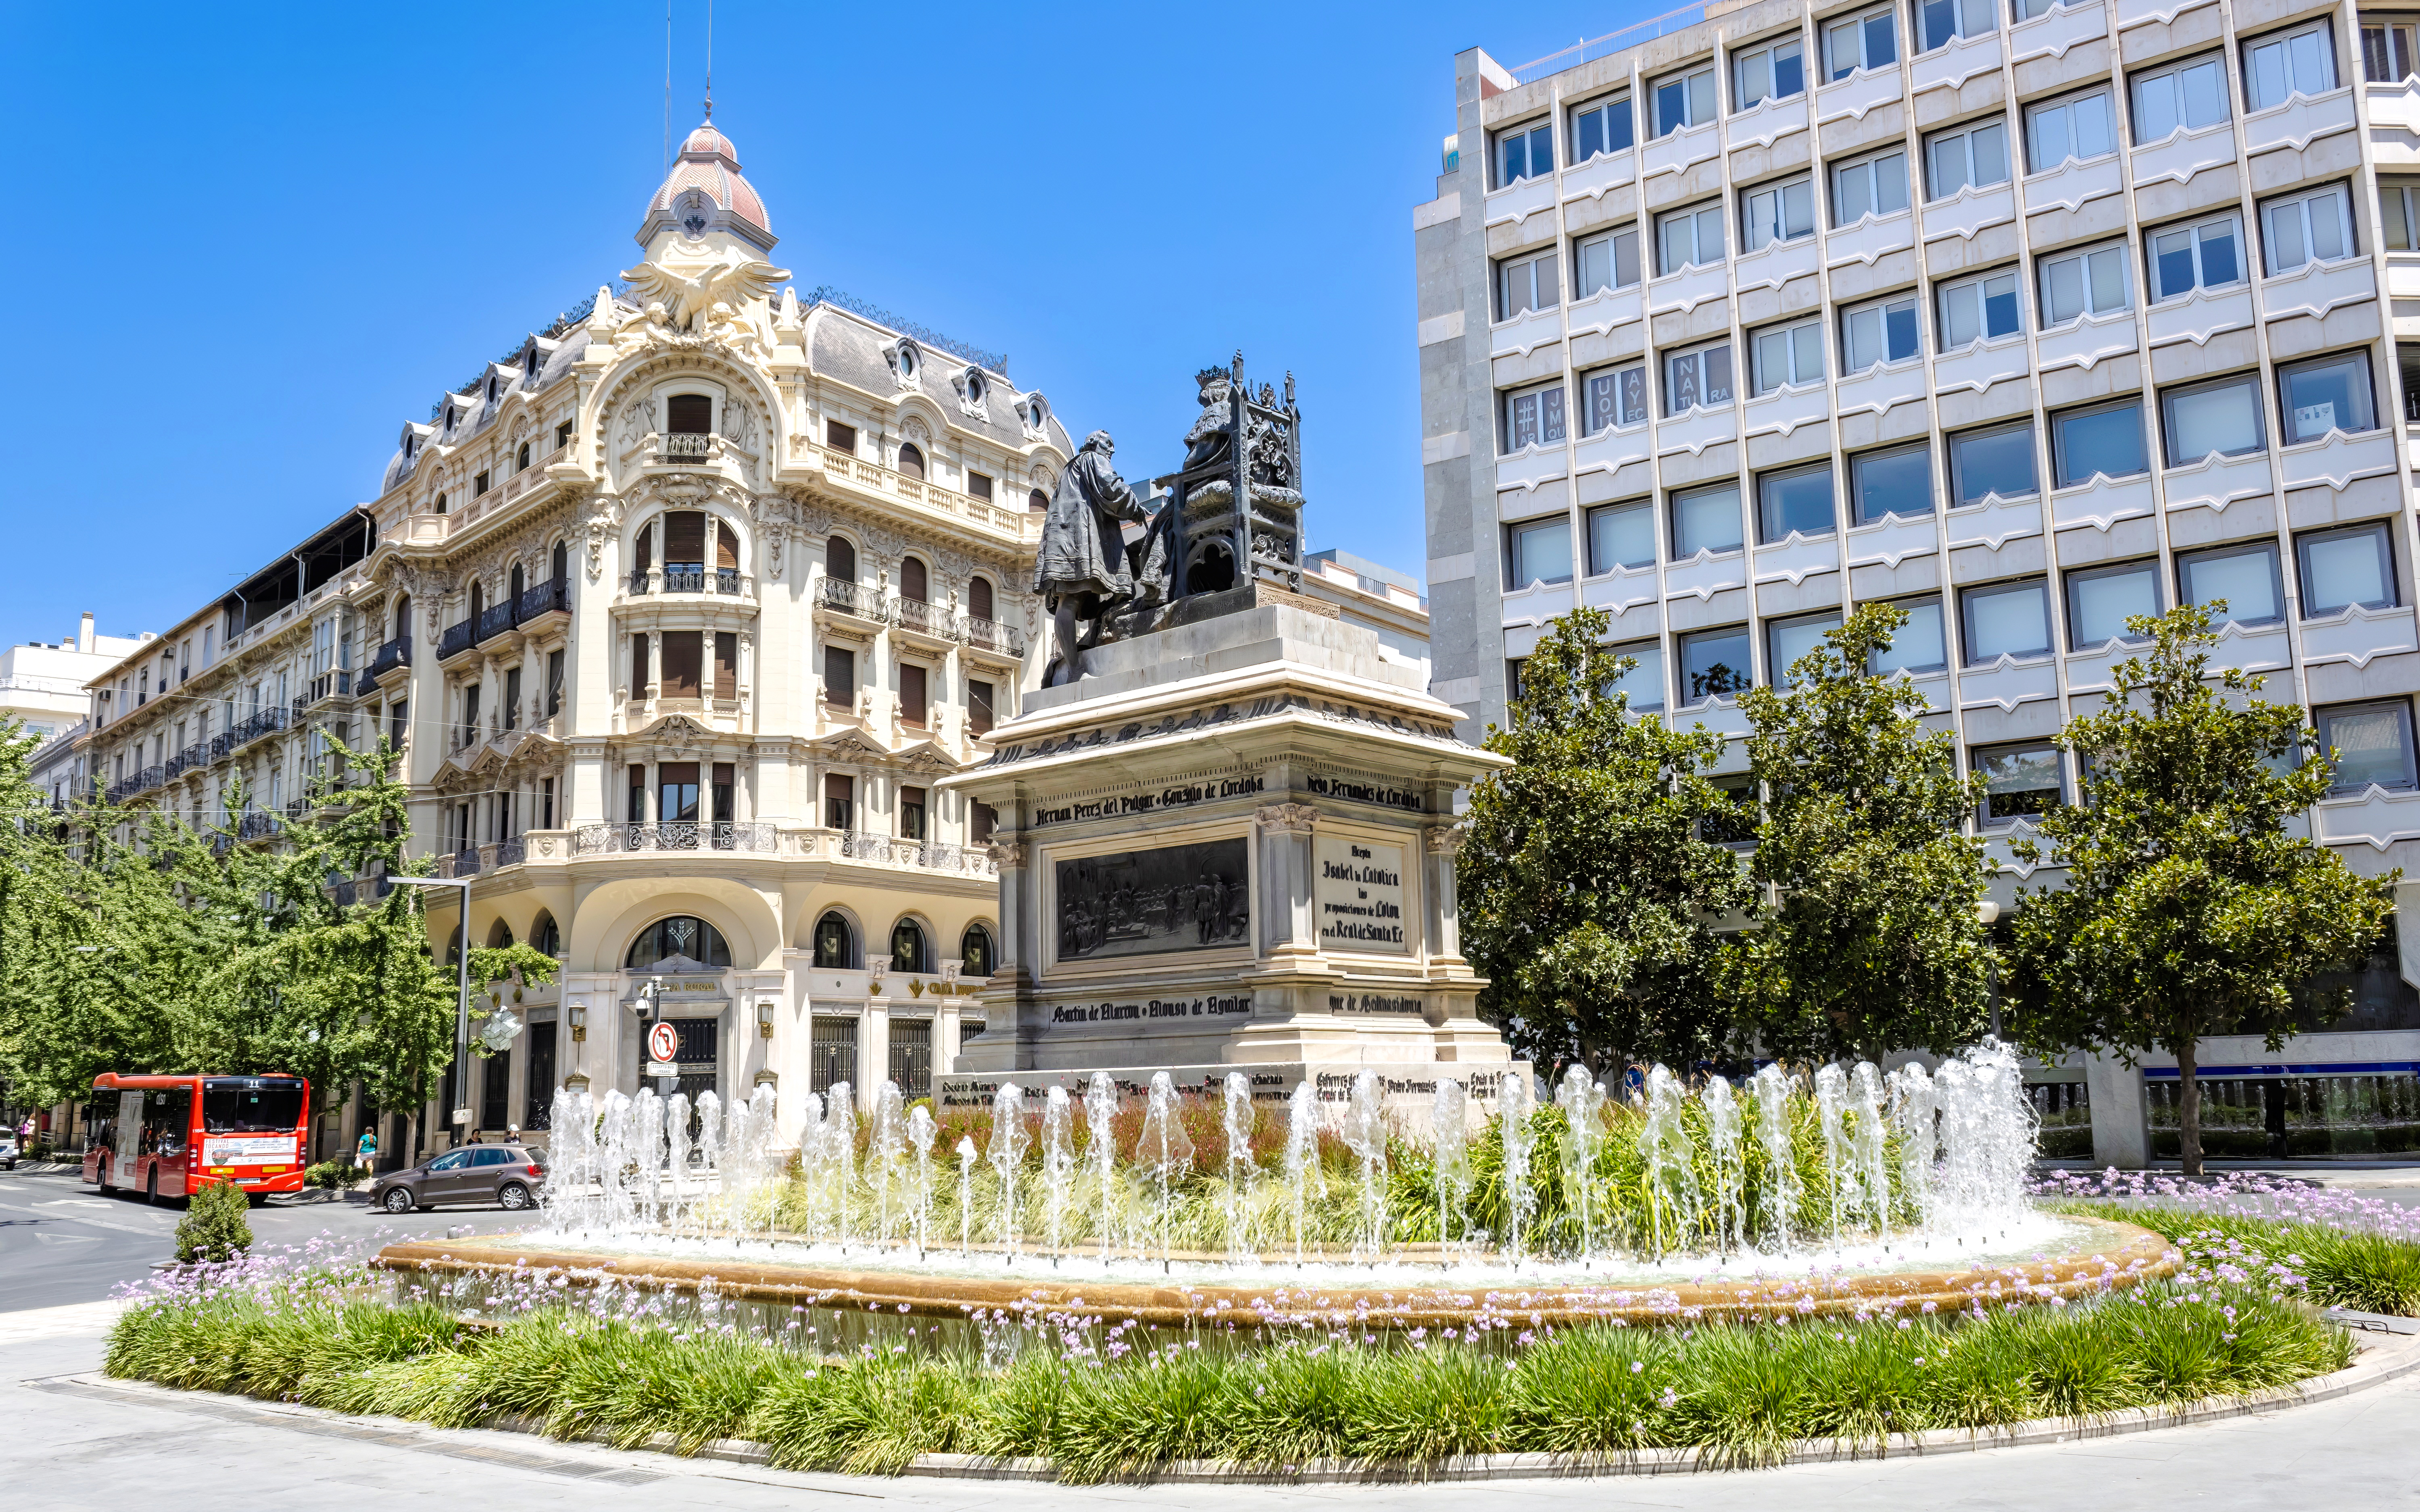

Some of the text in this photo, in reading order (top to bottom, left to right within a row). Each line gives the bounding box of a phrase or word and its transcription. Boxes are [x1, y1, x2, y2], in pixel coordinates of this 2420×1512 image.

[1035, 808, 1072, 826] Hernan
[1104, 798, 1118, 814] del
[1120, 794, 1155, 814] Pulgar
[1205, 782, 1216, 799] de
[1220, 775, 1264, 798] Cordoba
[1329, 779, 1374, 802] Fernandez
[1376, 786, 1385, 803] de
[1386, 788, 1421, 809] Cordoba
[1323, 861, 1399, 886] Isabel la Catolica
[1325, 900, 1400, 919] proposiciones de Colon
[1322, 920, 1403, 943] en el Real de Santa Fe
[684, 982, 716, 991] RURAL
[928, 982, 954, 995] CAJA
[1052, 995, 1250, 1023] Martin de Alarcon Alonso de Aguilar
[1348, 993, 1356, 1011] de
[248, 1080, 259, 1088] 11
